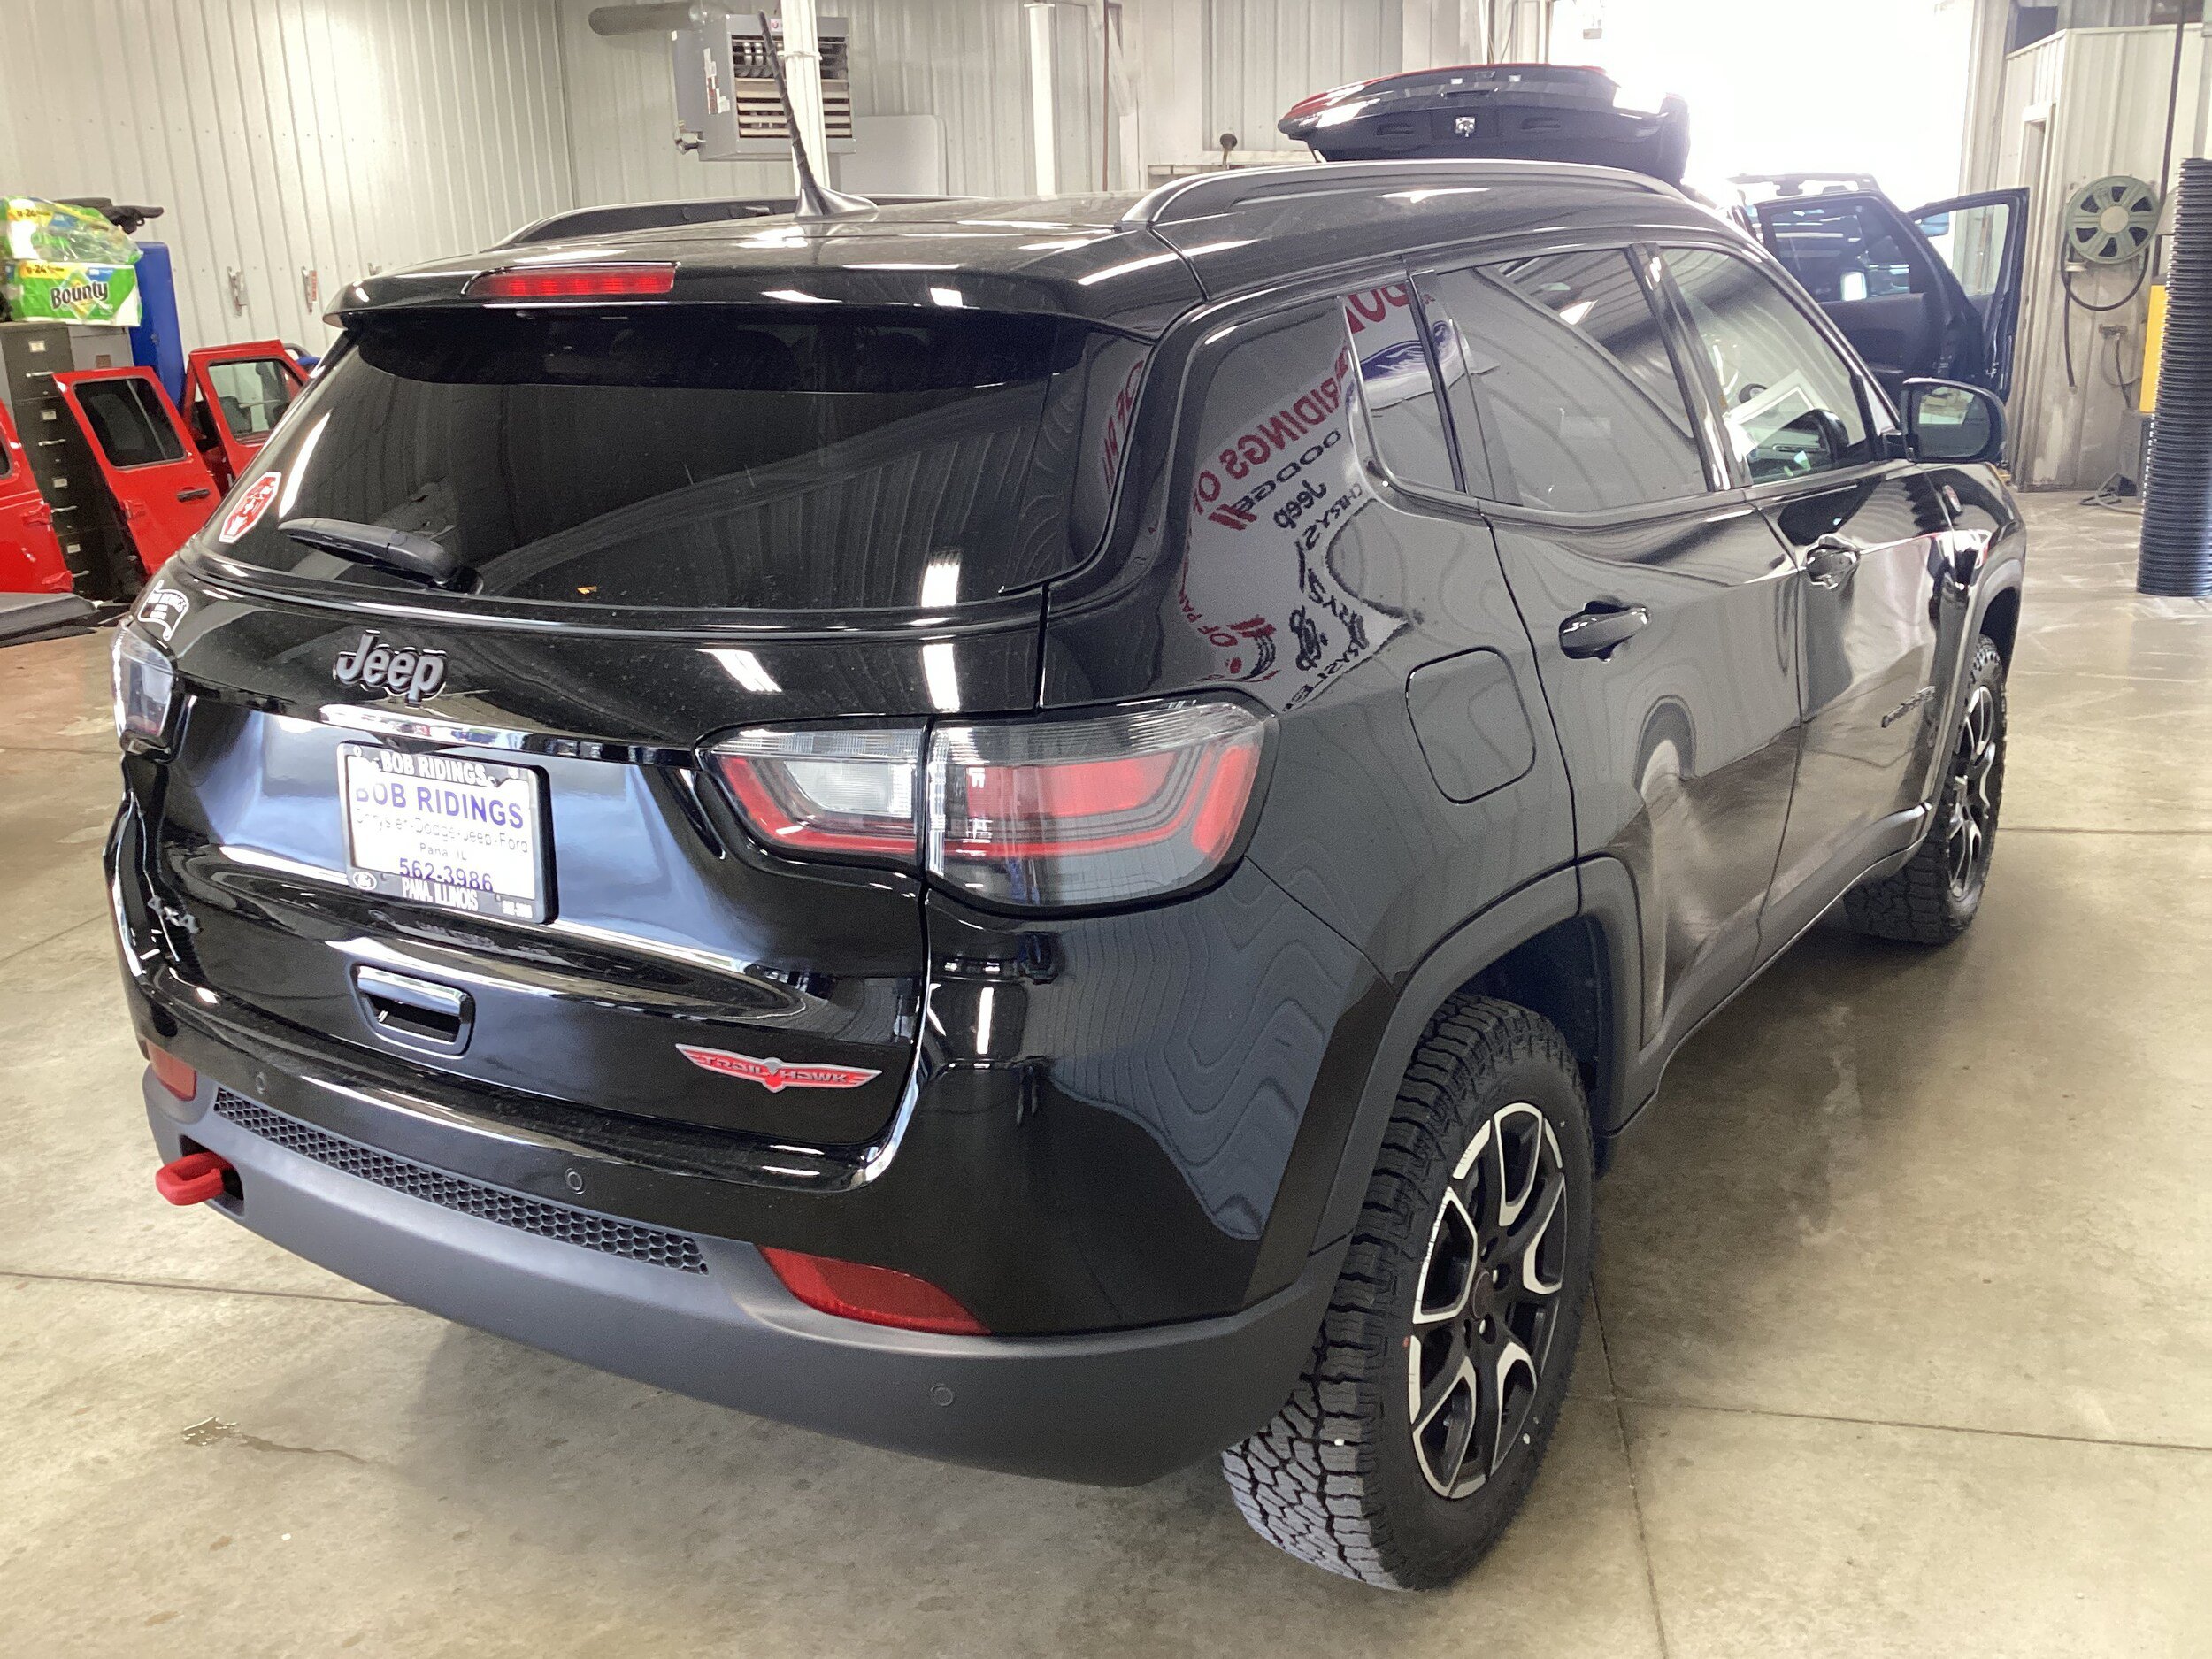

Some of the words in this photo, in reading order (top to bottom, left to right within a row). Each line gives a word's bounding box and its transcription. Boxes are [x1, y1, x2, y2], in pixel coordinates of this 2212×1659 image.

[50, 282, 108, 309] Bounty
[334, 629, 447, 708] Jeep
[380, 751, 415, 776] BOB
[418, 756, 488, 785] RIDINGS
[356, 783, 407, 809] BOB
[417, 786, 524, 829] RIDINGS
[419, 843, 449, 858] Pana
[399, 857, 494, 893] 562-3986
[434, 881, 479, 911] ILLINOIS
